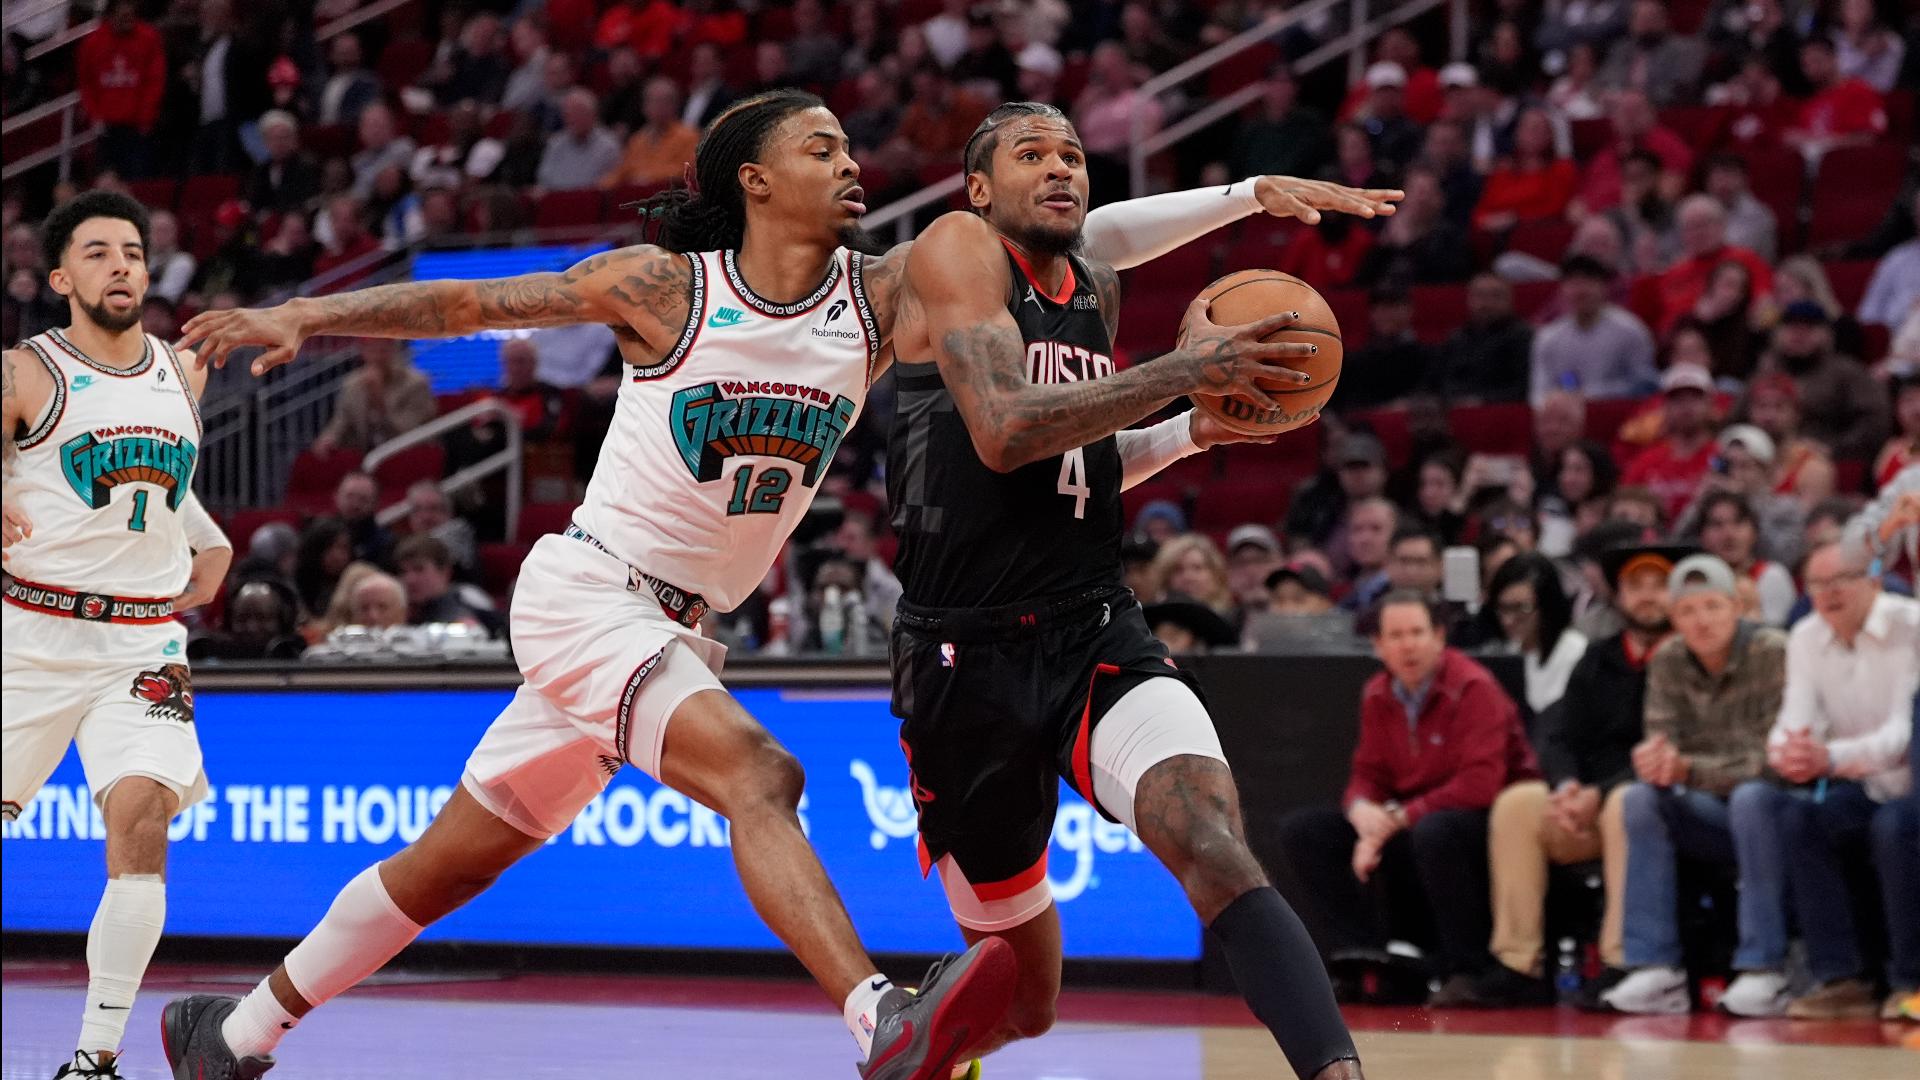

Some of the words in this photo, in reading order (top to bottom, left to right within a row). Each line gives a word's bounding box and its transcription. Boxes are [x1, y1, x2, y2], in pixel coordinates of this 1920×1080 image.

[716, 306, 744, 322] NIKE
[811, 327, 860, 340] Robinhood
[721, 381, 831, 405] VANCOUVER
[95, 426, 177, 442] VANCOUVER
[669, 382, 856, 488] GRIZZLIES
[59, 431, 197, 513] GRIZZLIES
[726, 464, 793, 517] 12
[1057, 446, 1091, 520] 4
[127, 489, 149, 533] 1
[226, 785, 310, 843] THE
